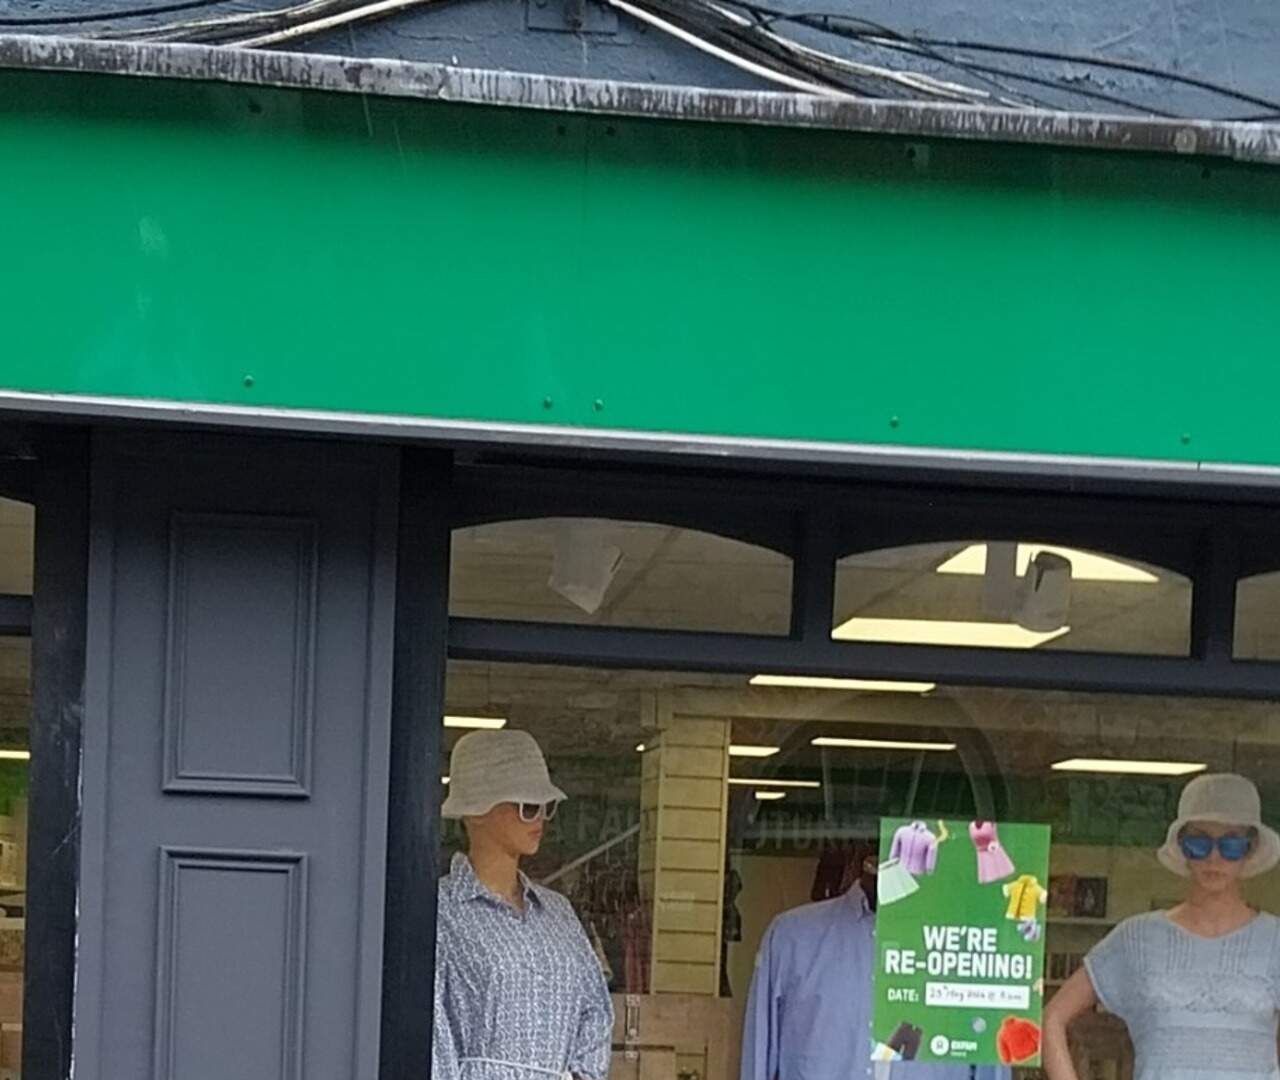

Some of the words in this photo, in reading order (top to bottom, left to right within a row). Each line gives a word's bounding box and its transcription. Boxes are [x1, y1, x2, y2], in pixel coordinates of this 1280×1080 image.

[922, 925, 998, 952] WE'RE
[884, 948, 1033, 979] RE-OPENING!
[887, 988, 920, 1003] DATE:
